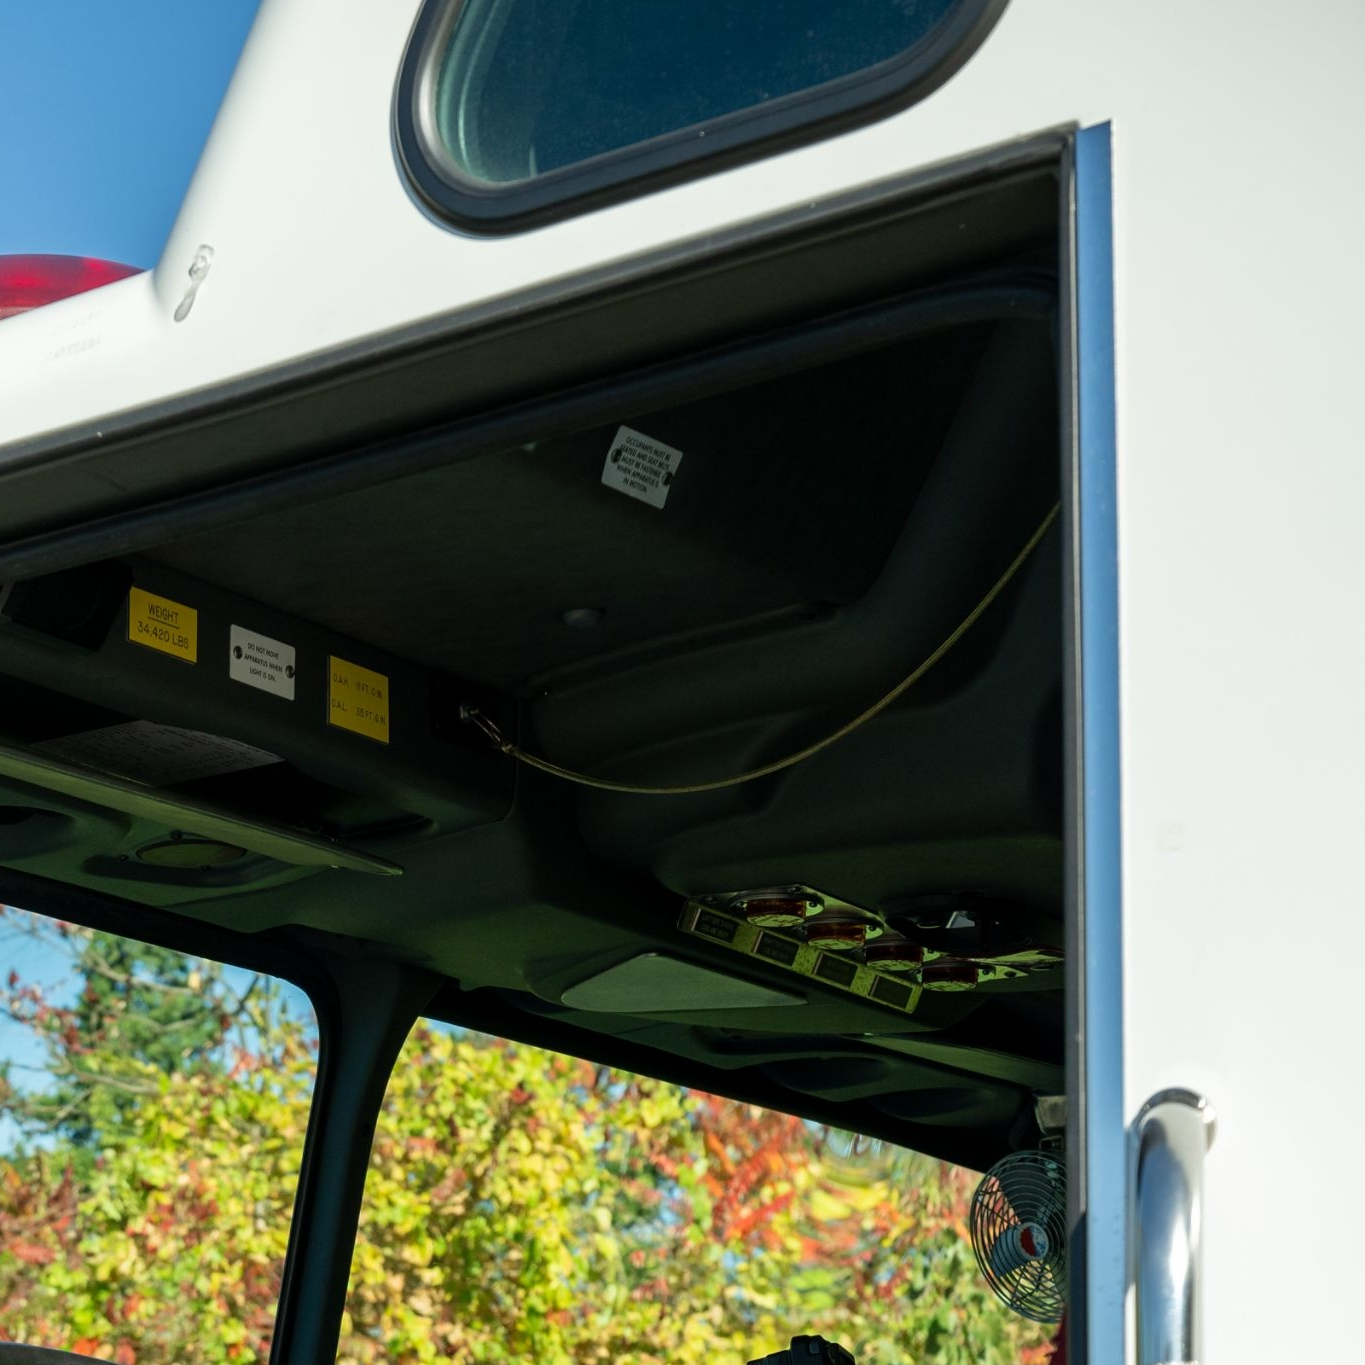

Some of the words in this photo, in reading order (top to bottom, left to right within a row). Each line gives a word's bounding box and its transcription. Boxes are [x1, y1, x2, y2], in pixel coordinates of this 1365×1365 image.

[626, 436, 653, 453] OCCUPANTS
[653, 448, 665, 459] MUST
[620, 455, 635, 466] MUST
[635, 451, 647, 460] AND
[148, 602, 179, 623] WEIGHT
[172, 633, 189, 649] LBS
[256, 646, 265, 654] NOT
[266, 649, 279, 659] MOVE
[244, 654, 268, 668] APPARATUS
[269, 663, 282, 672] WHEN
[250, 667, 262, 677] LIGHT
